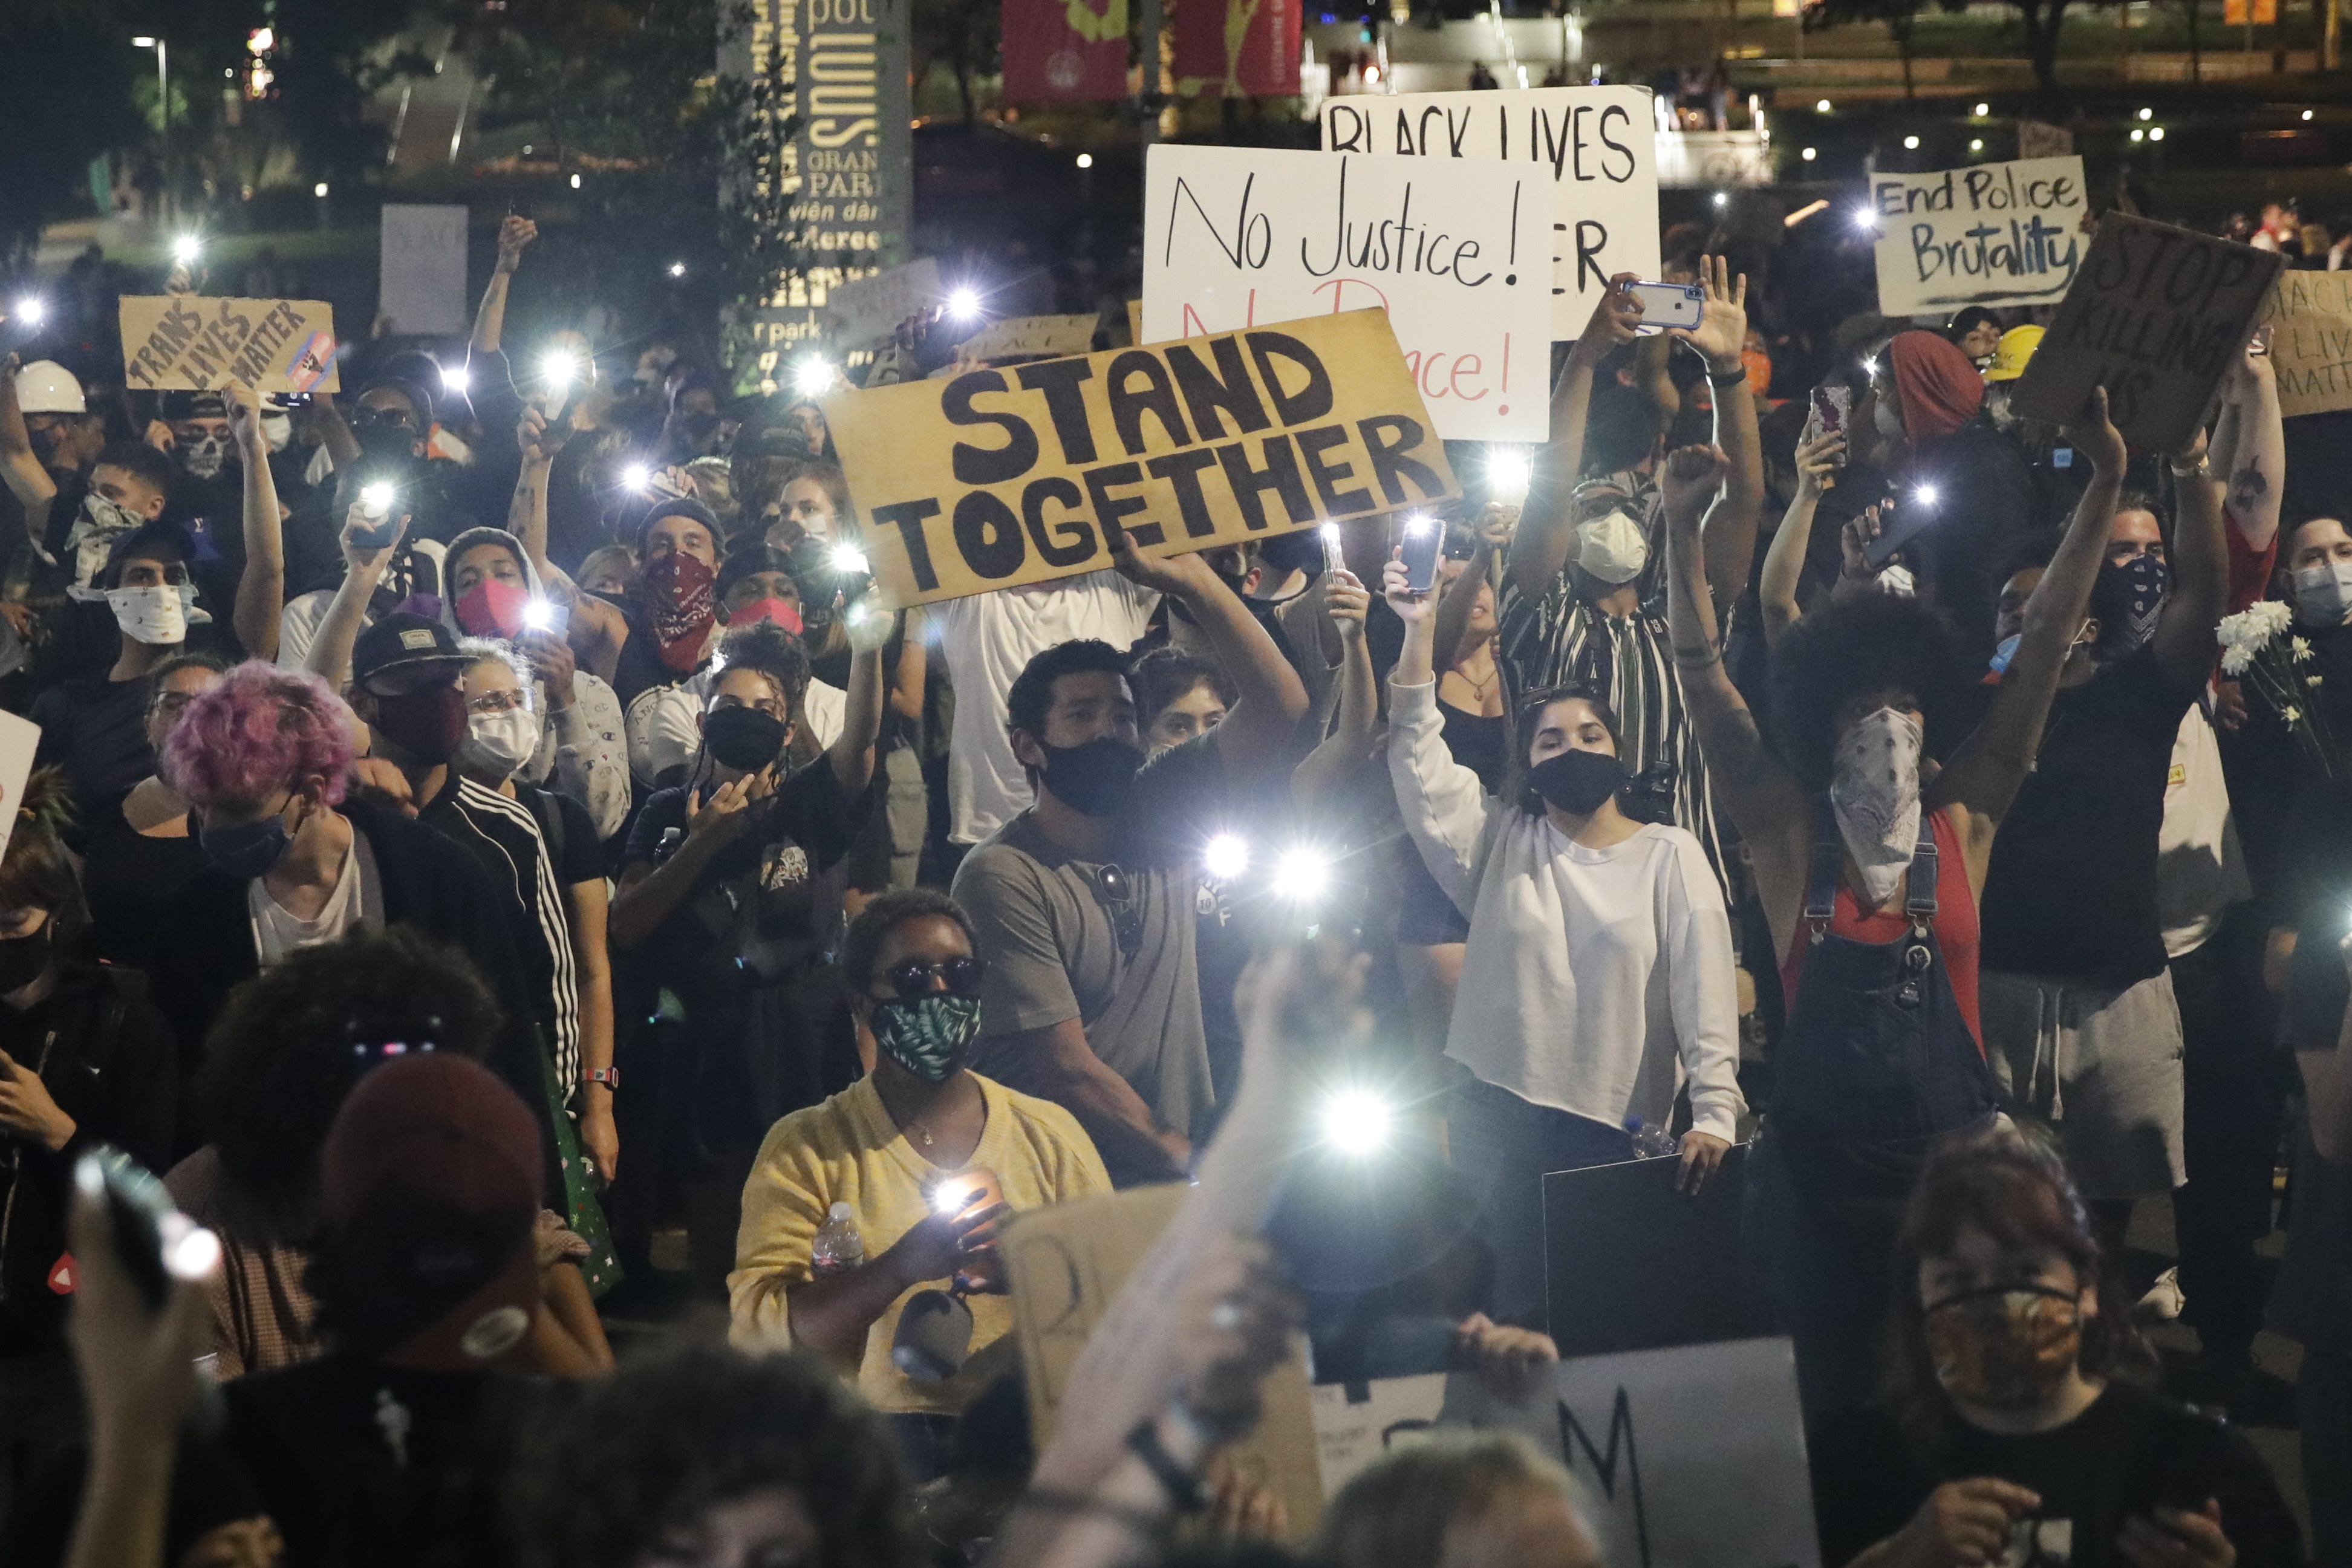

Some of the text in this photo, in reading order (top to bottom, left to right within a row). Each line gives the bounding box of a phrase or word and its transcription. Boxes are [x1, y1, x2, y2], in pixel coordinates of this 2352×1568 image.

[1167, 155, 1520, 287] No Justice!
[1877, 165, 2079, 216] End Police
[1912, 215, 2079, 291] Brutality
[2094, 222, 2255, 315] STOP
[128, 300, 201, 388] TRANS
[180, 300, 250, 389] LIVES
[229, 302, 306, 388] MATTER
[2062, 298, 2236, 376] KILLING
[940, 331, 1334, 485] STAND
[871, 414, 1446, 593] TOGETHER
